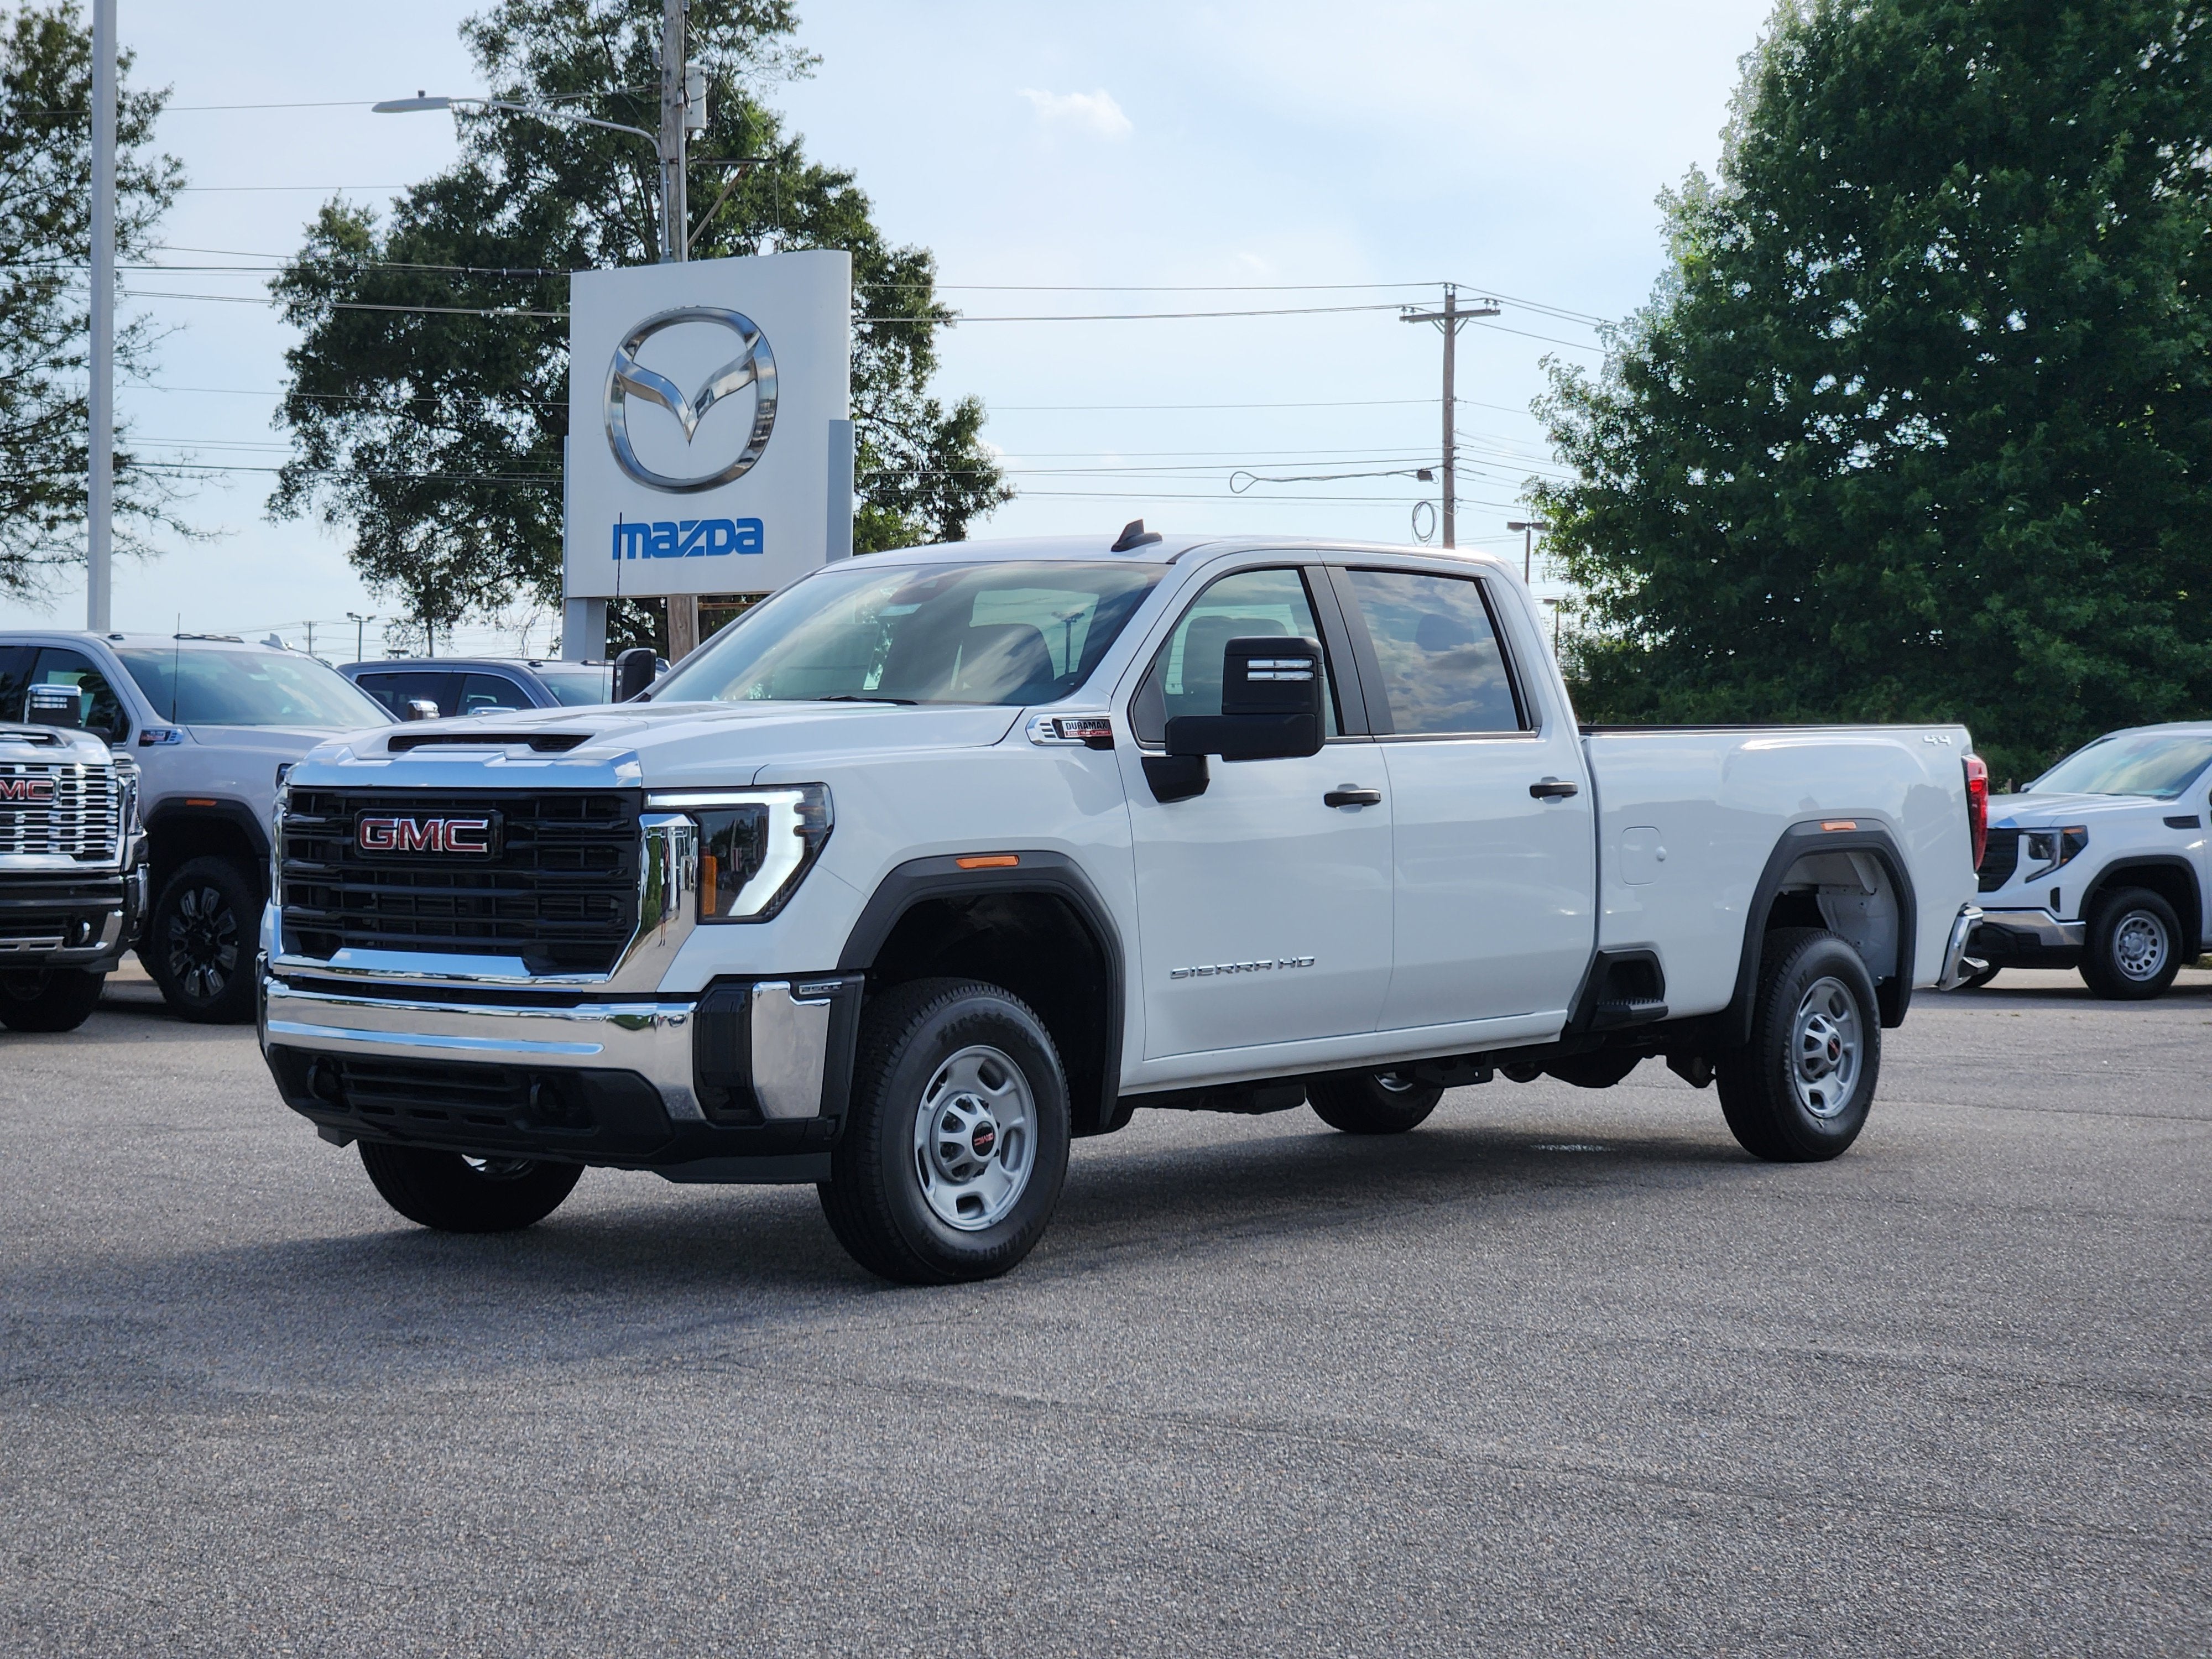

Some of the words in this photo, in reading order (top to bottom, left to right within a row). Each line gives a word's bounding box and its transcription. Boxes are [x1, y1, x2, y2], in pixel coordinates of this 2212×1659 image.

[1065, 721, 1107, 730] DURAMAX
[0, 780, 54, 800] MC
[360, 817, 488, 853] GMC
[1170, 959, 1272, 979] SIERRA
[1278, 956, 1314, 969] HD
